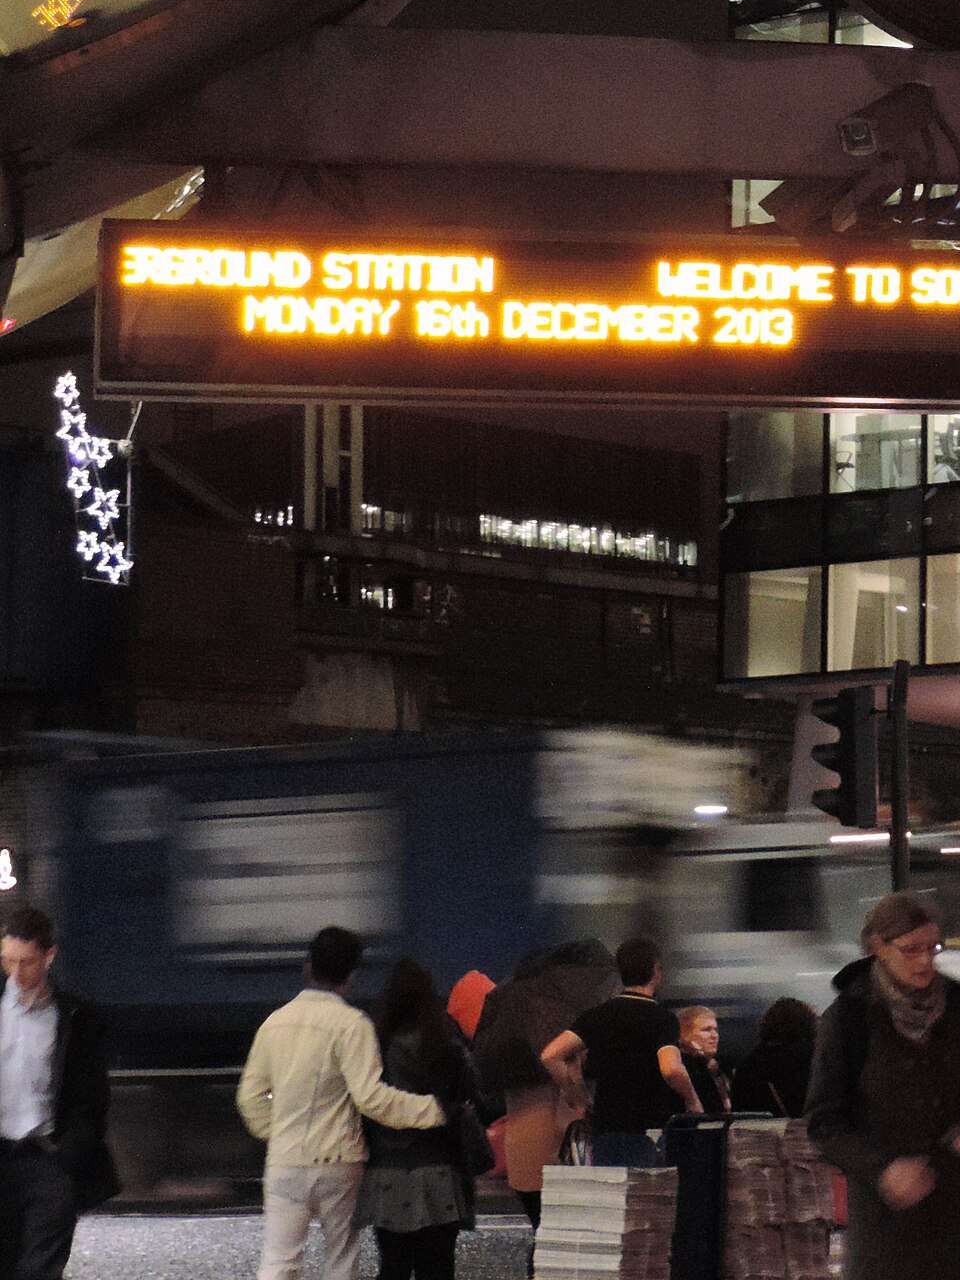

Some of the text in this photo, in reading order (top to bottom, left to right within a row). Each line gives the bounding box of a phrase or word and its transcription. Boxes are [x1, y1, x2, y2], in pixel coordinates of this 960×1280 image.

[321, 251, 496, 293] STATION
[655, 260, 835, 304] WELCOME
[845, 266, 903, 305] TO
[241, 294, 796, 348] MONDAY 16th DECEMBER 2013
